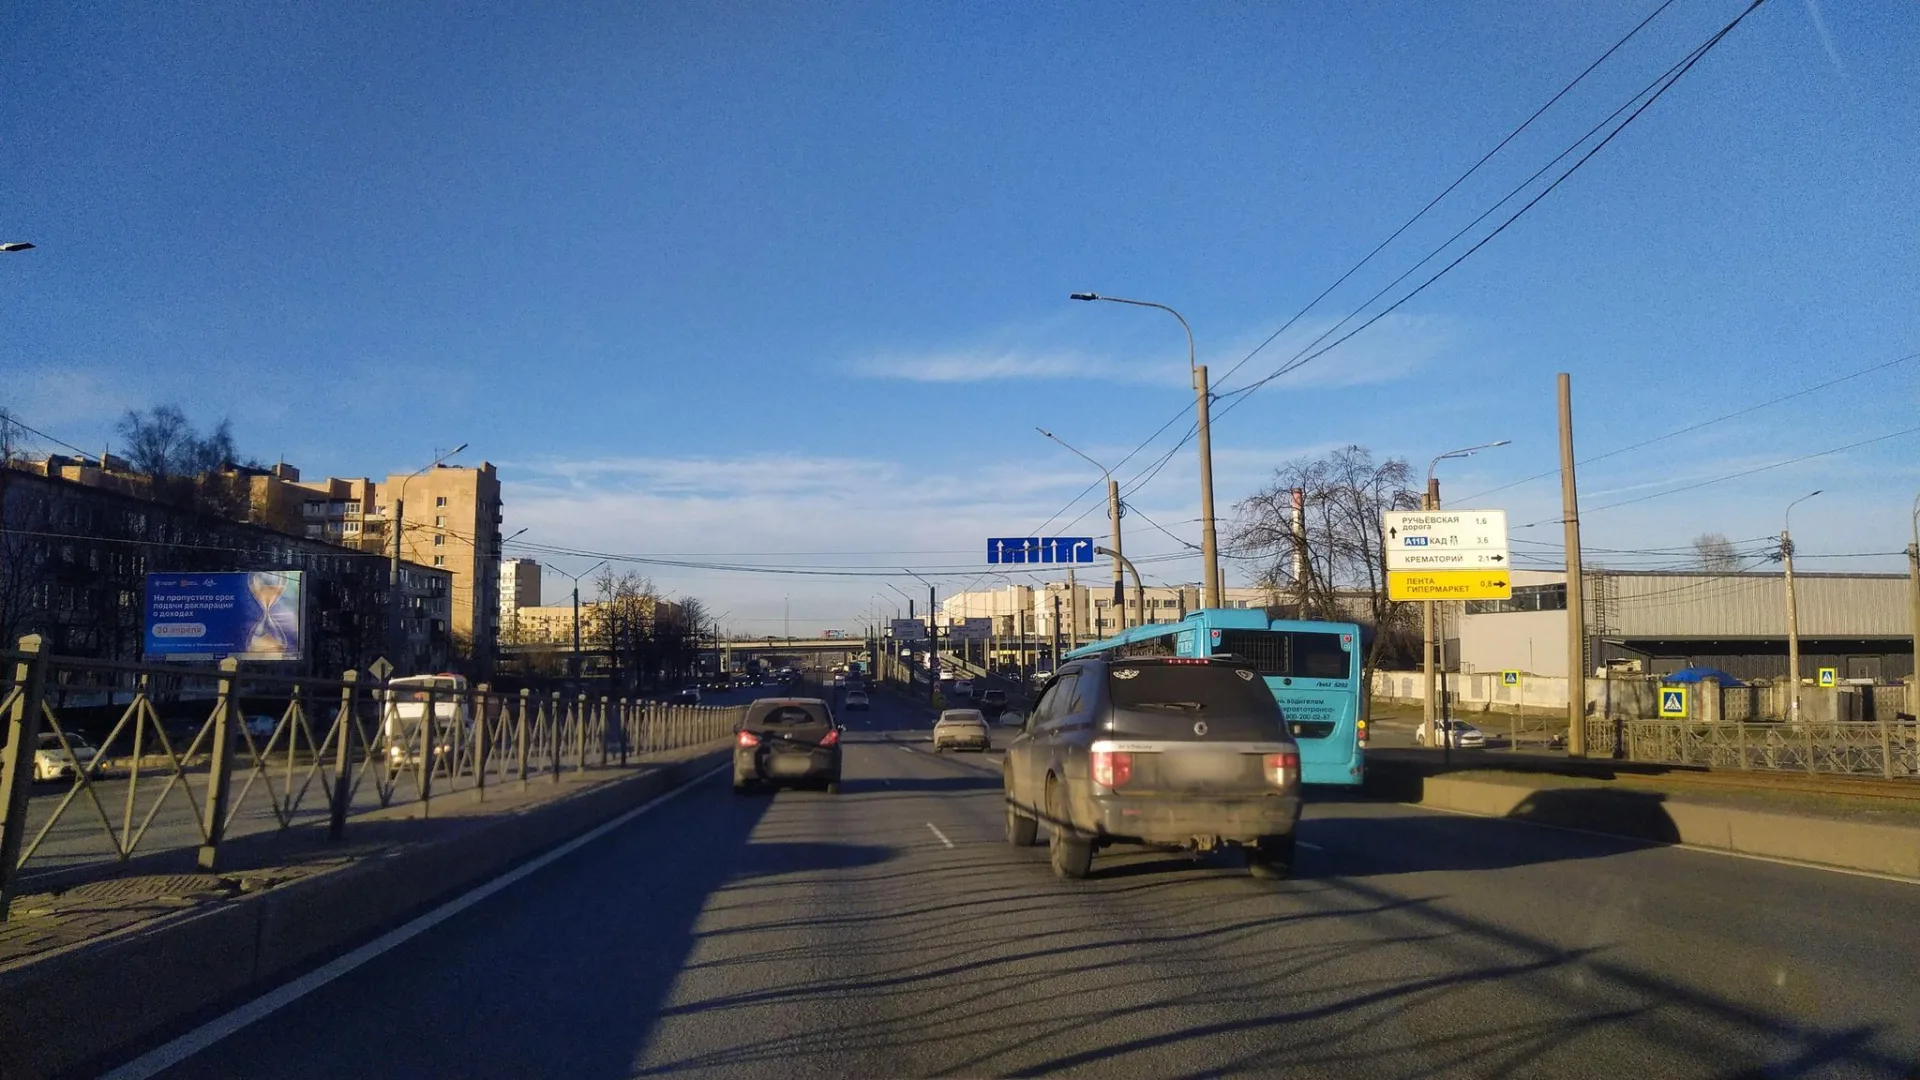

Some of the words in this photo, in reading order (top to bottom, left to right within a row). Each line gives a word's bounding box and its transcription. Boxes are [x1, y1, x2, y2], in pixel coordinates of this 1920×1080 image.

[1429, 537, 1448, 545] КАД
[1477, 537, 1489, 545] 3,6
[1405, 554, 1464, 563] КРЕМАТОРИЙ
[1406, 577, 1435, 585] ЛЕНТА
[1406, 585, 1470, 593] ГИПЕРМАРКЕТ
[170, 627, 202, 635] апреля
